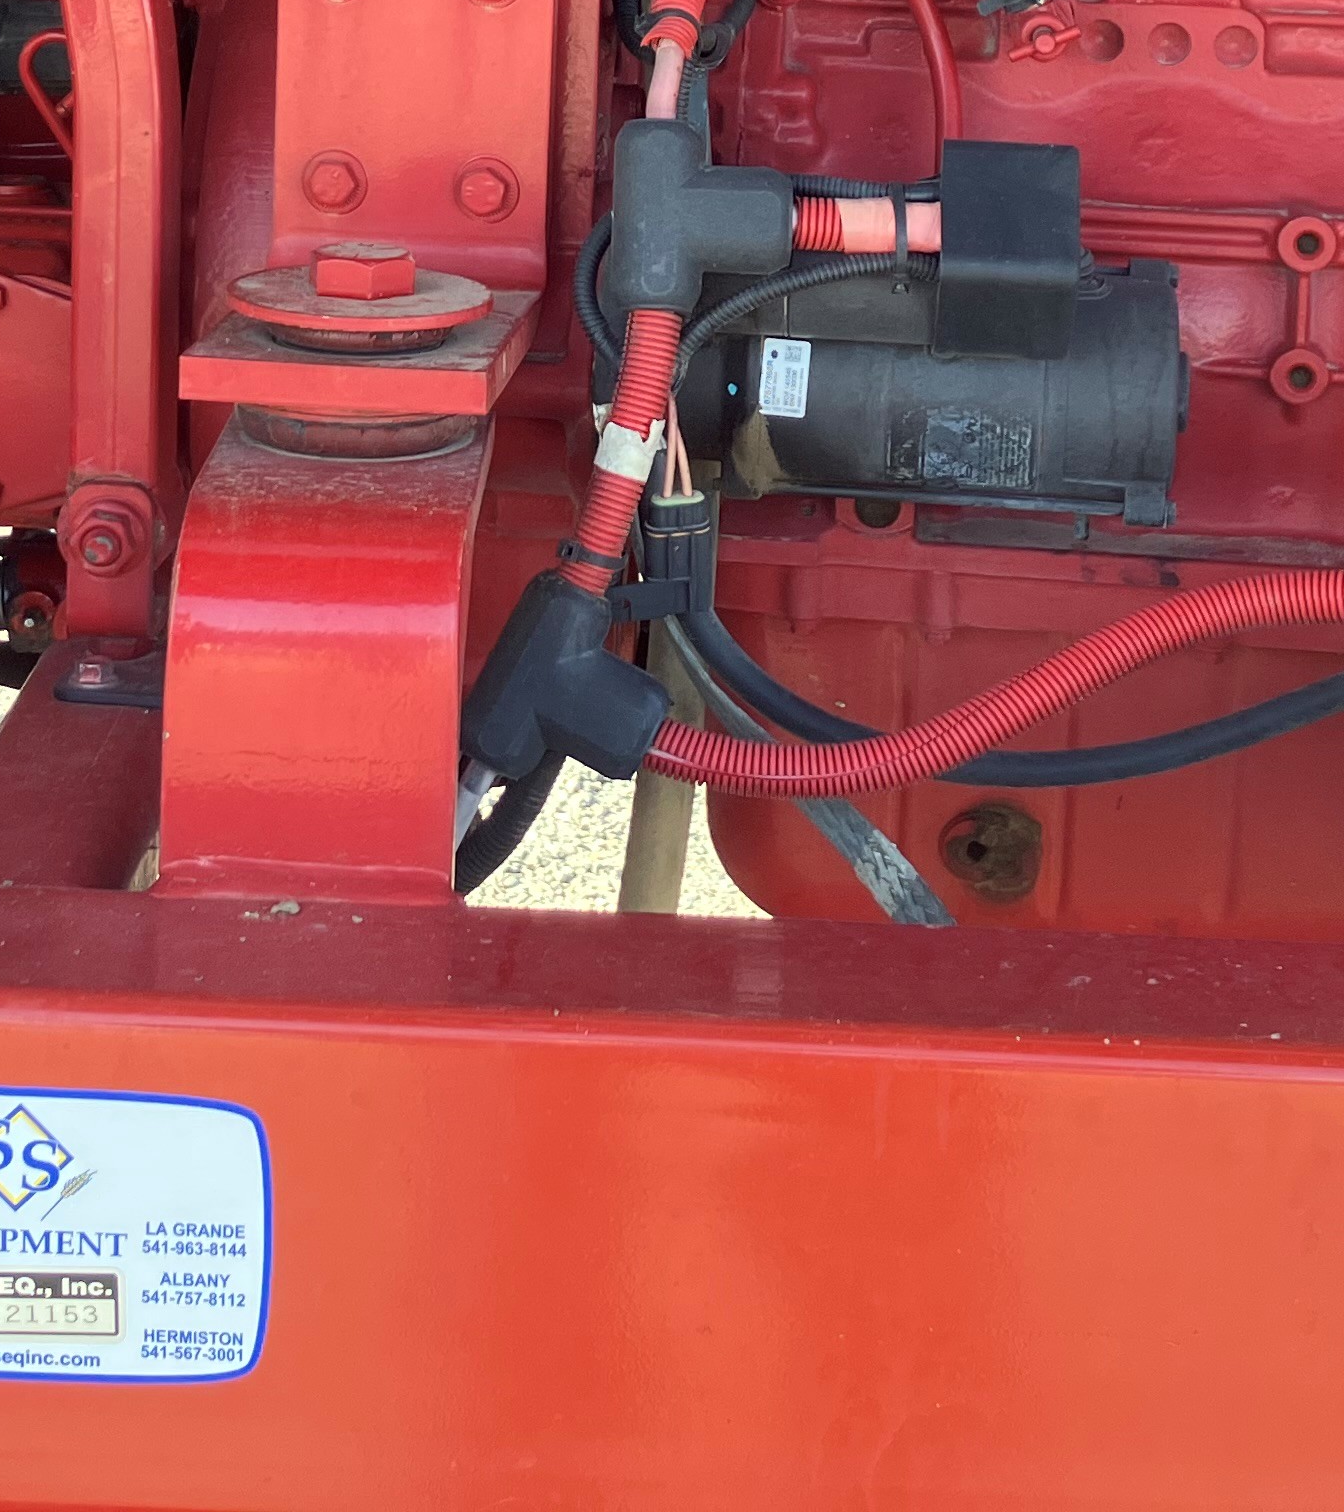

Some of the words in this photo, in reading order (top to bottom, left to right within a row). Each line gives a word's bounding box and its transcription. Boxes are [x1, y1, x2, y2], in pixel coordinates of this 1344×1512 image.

[145, 1221, 168, 1238] LA
[171, 1222, 246, 1240] GRANDE
[142, 1240, 247, 1258] 541-963-8144
[61, 1277, 114, 1297] Inc.
[159, 1271, 230, 1288] ALBANY
[141, 1289, 245, 1307] 541-757-8112
[143, 1329, 244, 1347] HERMISTON
[141, 1345, 244, 1363] 541-567-3001
